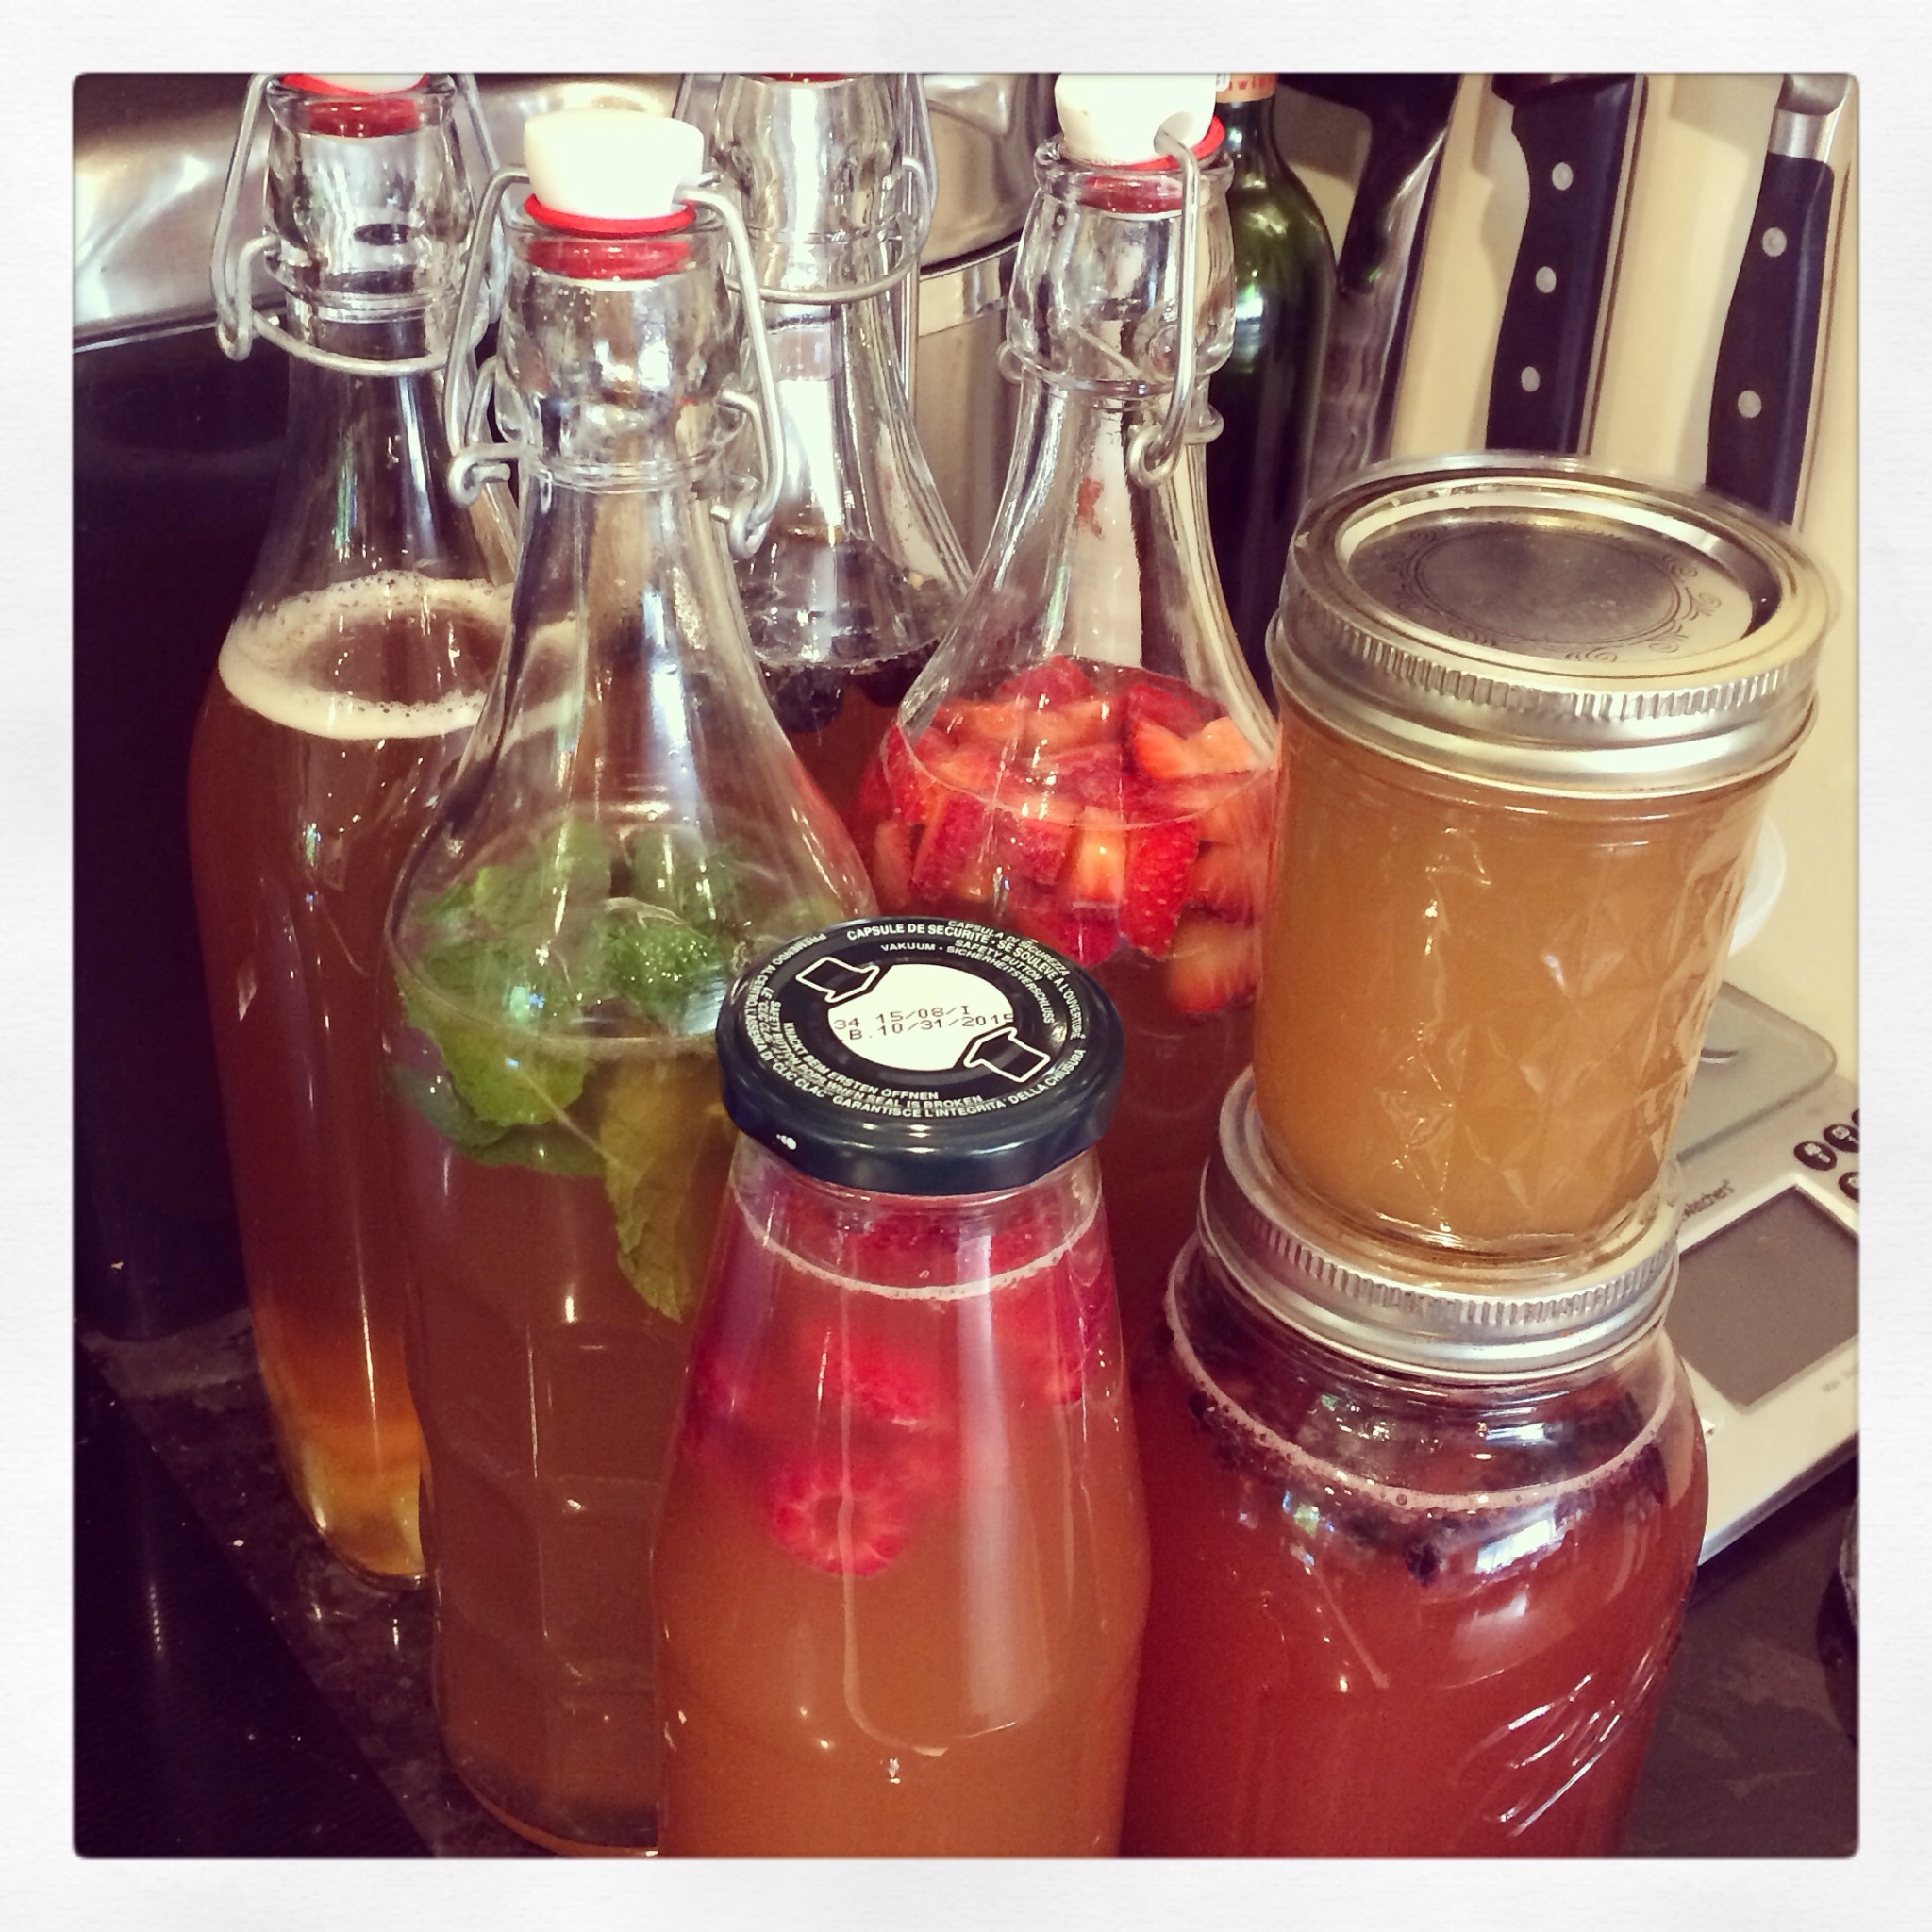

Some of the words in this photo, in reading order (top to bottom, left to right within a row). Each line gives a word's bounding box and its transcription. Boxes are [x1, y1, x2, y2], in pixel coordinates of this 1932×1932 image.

[847, 924, 905, 941] CAPSULE
[908, 924, 925, 934] DE
[927, 924, 990, 944] SECURITE
[772, 933, 827, 966] PREMENDO
[948, 920, 1004, 939] CAPSULA
[1006, 935, 1021, 944] DI
[1018, 939, 1071, 976] SICUREZZA
[997, 940, 1015, 953] SE
[760, 963, 777, 974] AL
[954, 940, 1003, 958] SAFETY
[1001, 955, 1043, 981] BUTTON
[1013, 948, 1058, 981] SOULEVE
[880, 942, 936, 952] VAKUUM
[946, 945, 1056, 1024] SICHERHEITSVERSCHLUSS
[1054, 977, 1065, 988] A
[760, 986, 774, 1000] LE
[769, 1000, 782, 1032] SAFETY
[1058, 984, 1083, 1040] L'OUVERTURE
[834, 1017, 860, 1031] 34
[760, 1050, 774, 1061] DI
[772, 1033, 802, 1064] BUTTON
[783, 1022, 809, 1055] KNACKT
[803, 1054, 831, 1074] BEIM
[827, 1071, 879, 1094] ERSTEN
[880, 1088, 939, 1100] ÖFFNEN
[1044, 1049, 1087, 1087] CHIUSURA
[827, 1080, 865, 1100] WHEN
[867, 1092, 902, 1107] SEAL
[1008, 1083, 1049, 1105] DELLA
[832, 1096, 922, 1118] GARANTISCE
[907, 1099, 921, 1108] IS
[924, 1094, 984, 1109] BROKEN
